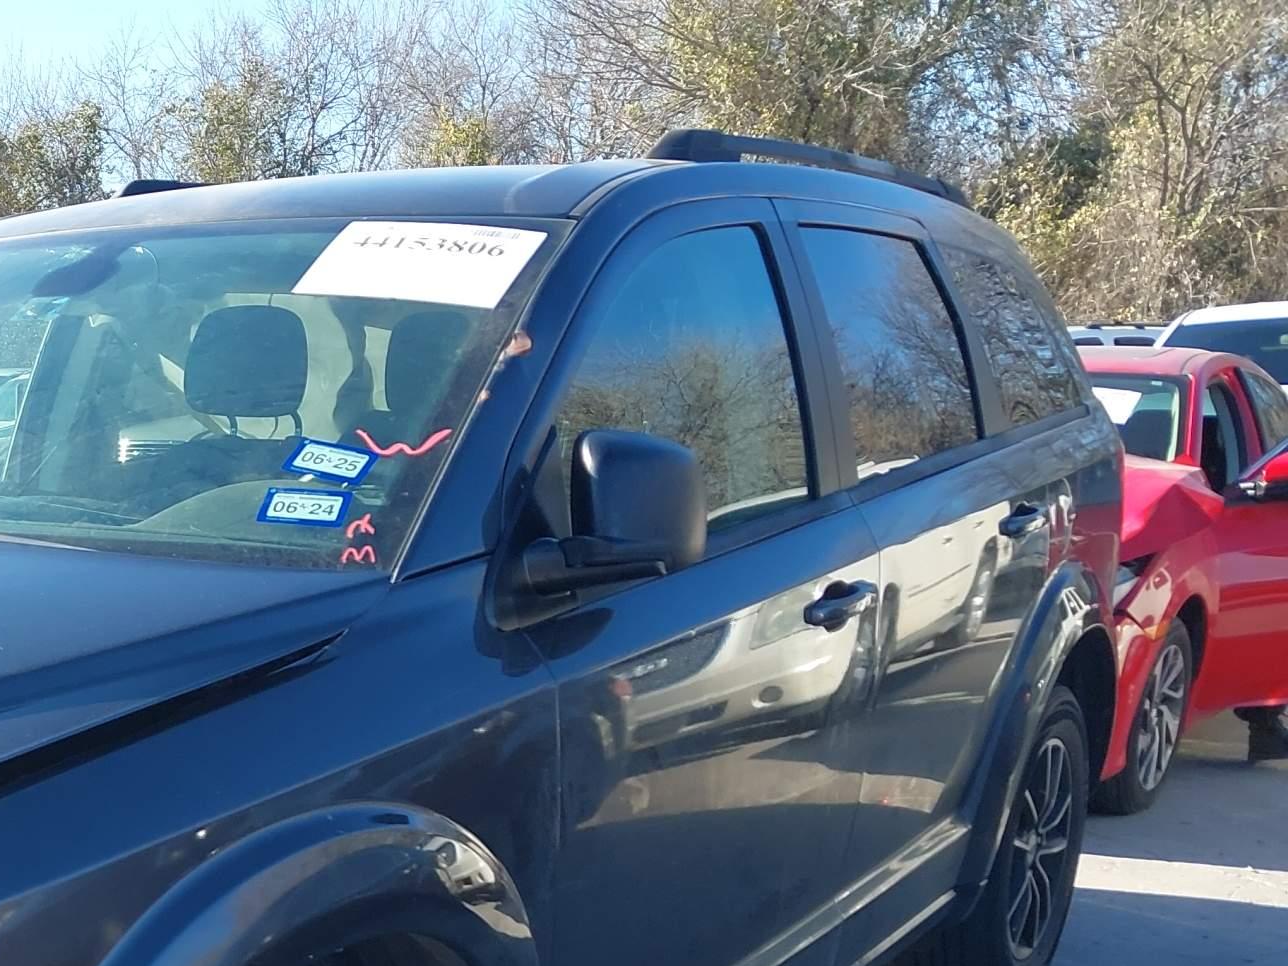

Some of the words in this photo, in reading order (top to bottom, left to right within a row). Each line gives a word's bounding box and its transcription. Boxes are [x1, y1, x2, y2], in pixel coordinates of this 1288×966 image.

[301, 451, 327, 465] 06
[332, 457, 361, 472] 25
[272, 500, 298, 514] 06
[308, 502, 336, 516] 24
